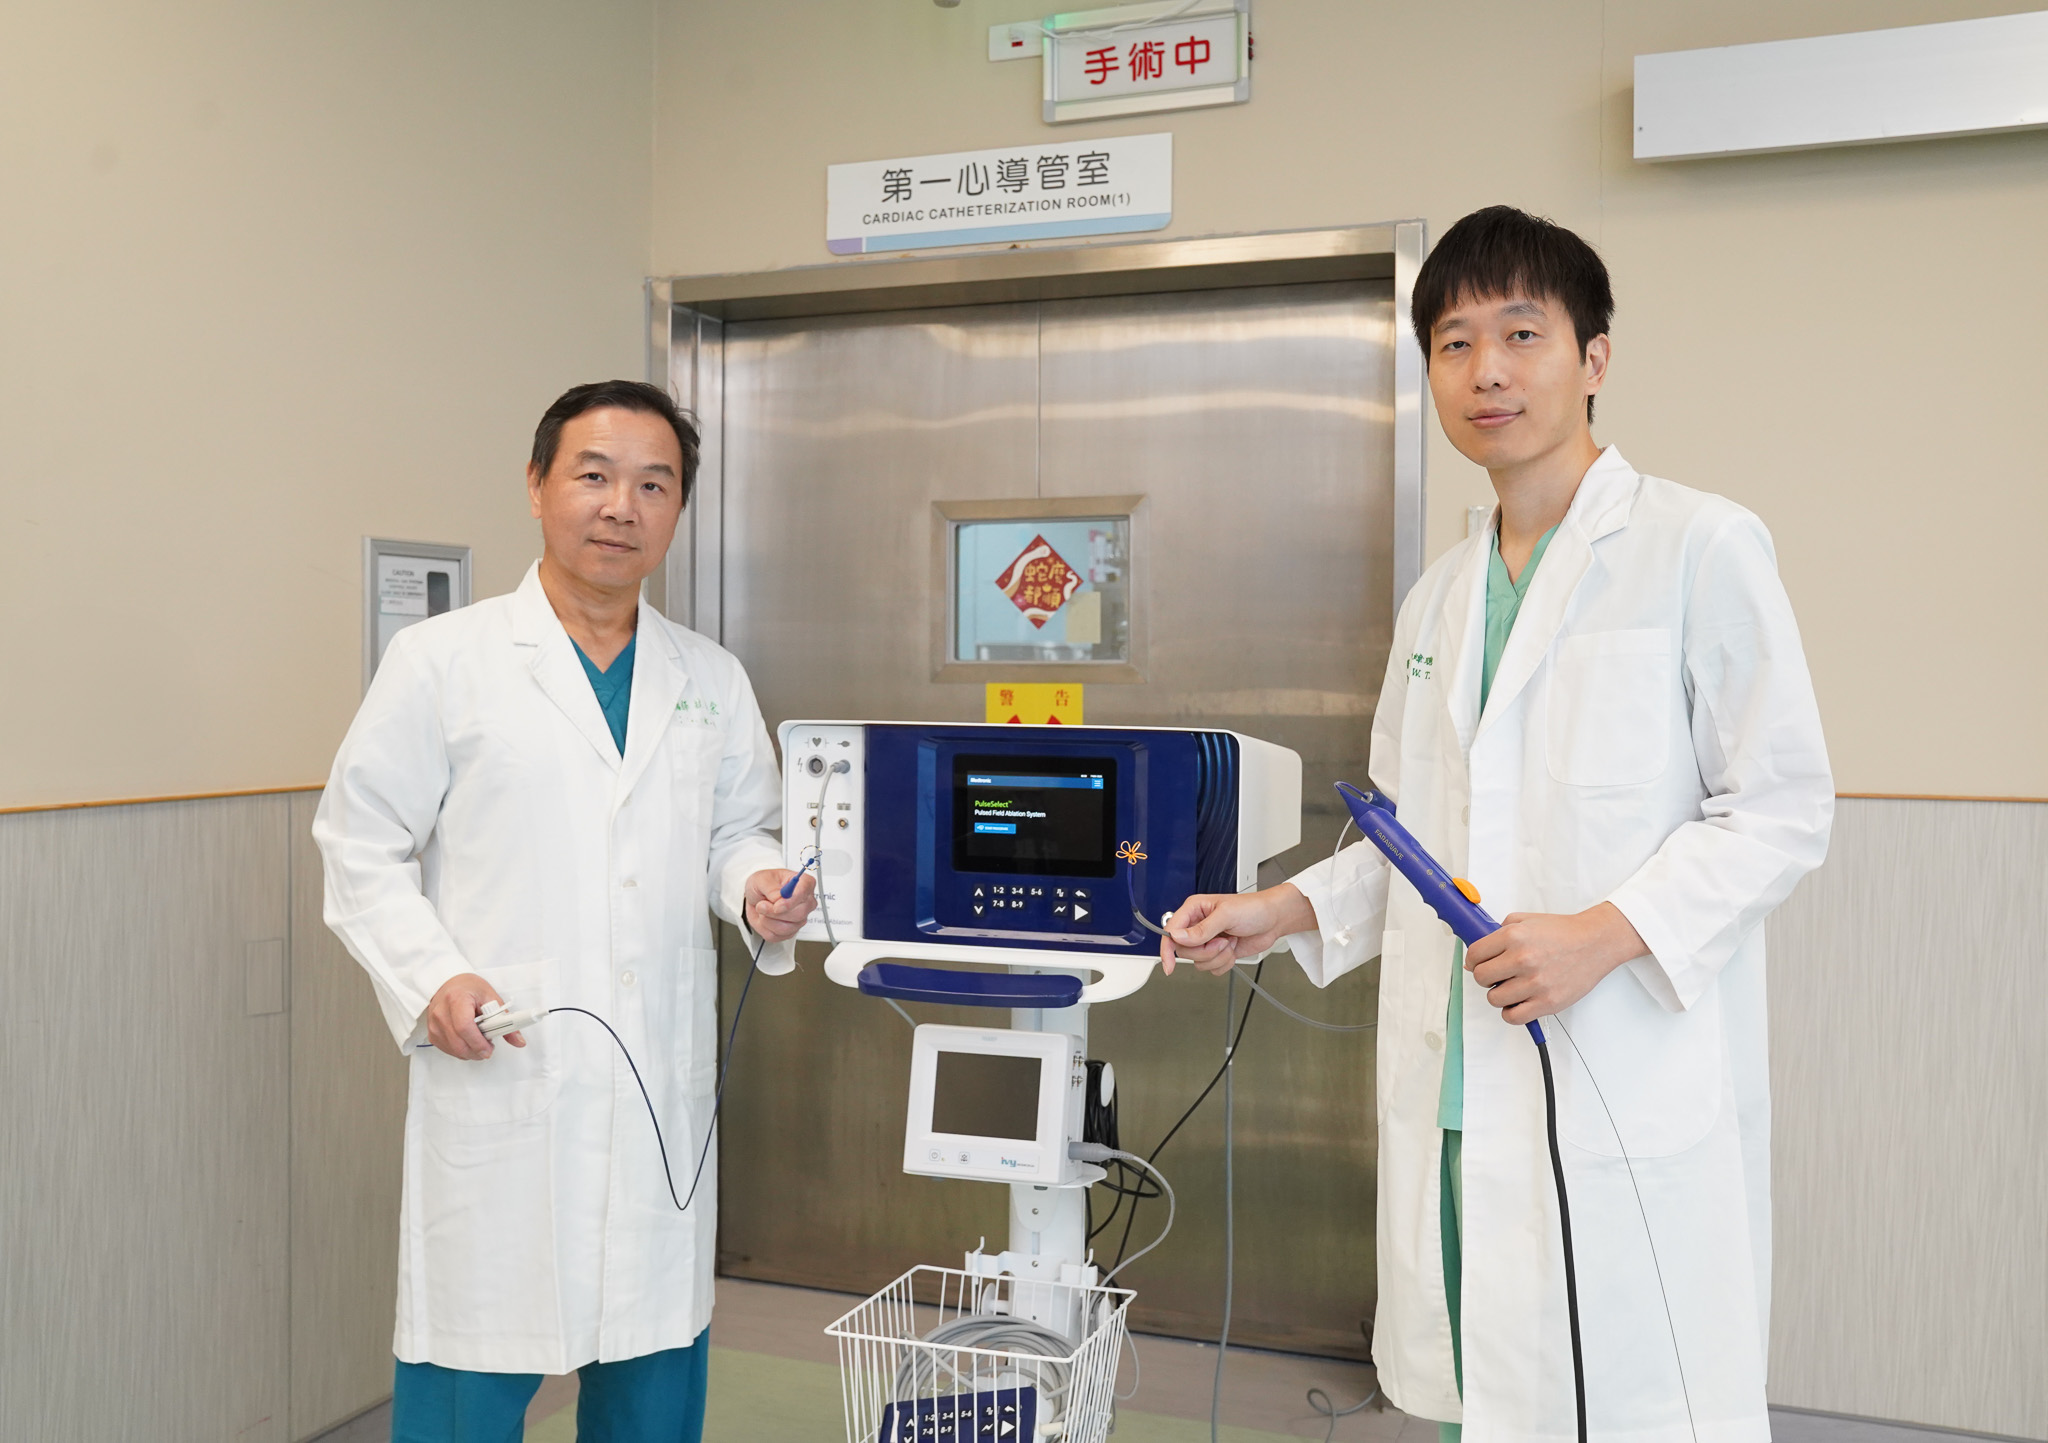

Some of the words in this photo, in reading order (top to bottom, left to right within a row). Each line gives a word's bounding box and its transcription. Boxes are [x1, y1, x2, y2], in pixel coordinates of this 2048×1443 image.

[1084, 35, 1210, 85] 手術中
[881, 150, 1110, 204] 第一心導管室
[862, 210, 924, 225] CARDIAC
[928, 198, 1062, 220] CATHETERIZATION
[1066, 192, 1132, 209] ROOM(1)
[1000, 689, 1070, 707] 警告
[1374, 829, 1405, 861] FARAWAVE
[993, 886, 1005, 894] 1-2
[1011, 887, 1024, 895] 3-4
[1030, 888, 1043, 896] 5-6
[993, 900, 1005, 908] 7-8
[942, 1411, 954, 1420] 3-4
[960, 1410, 972, 1418] 5-6
